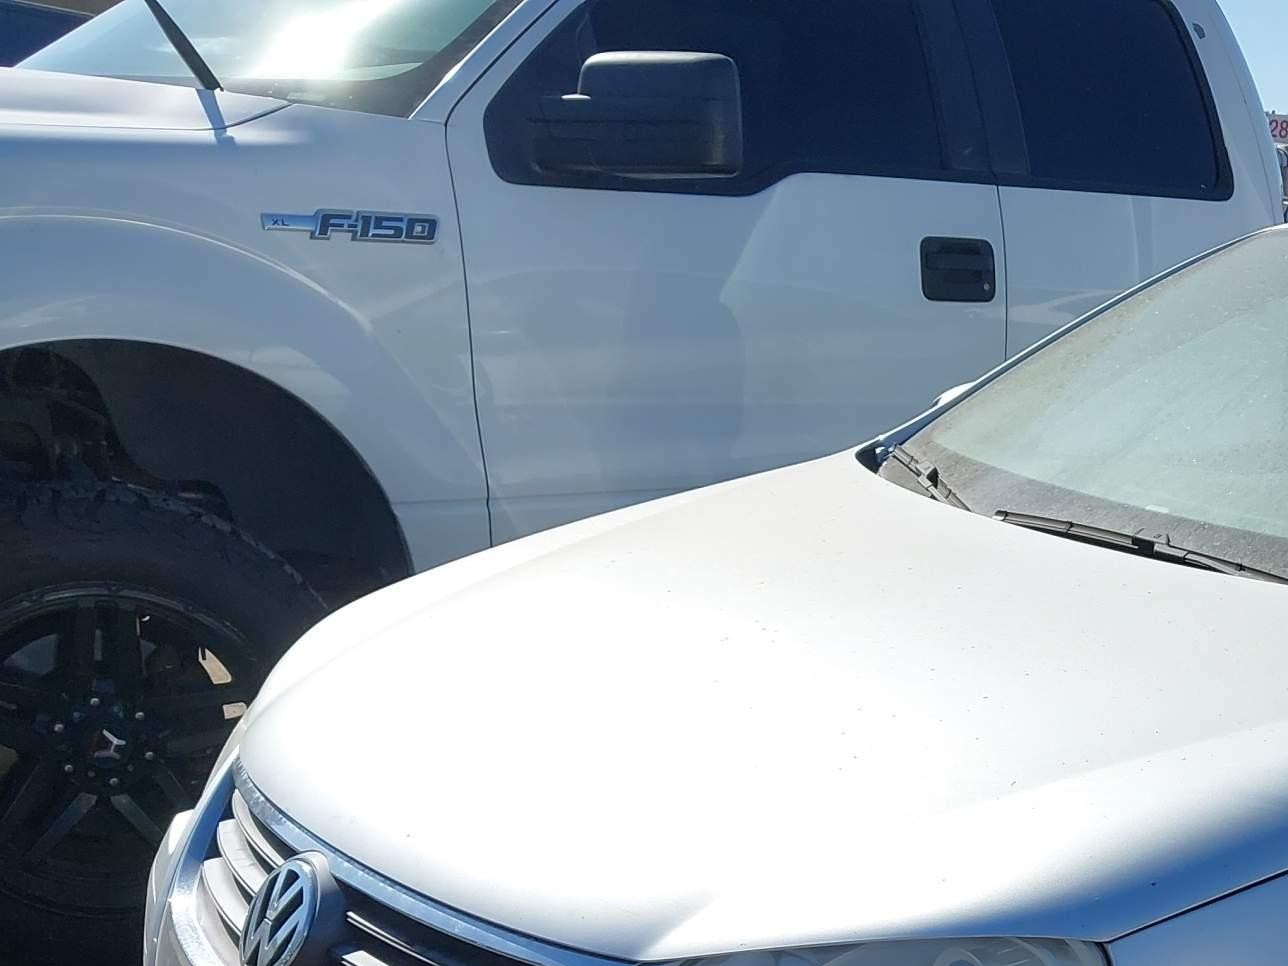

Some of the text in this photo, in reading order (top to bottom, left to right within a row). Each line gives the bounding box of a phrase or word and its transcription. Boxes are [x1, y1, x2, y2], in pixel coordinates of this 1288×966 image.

[1269, 119, 1288, 138] 28
[271, 210, 439, 243] XL F-150
